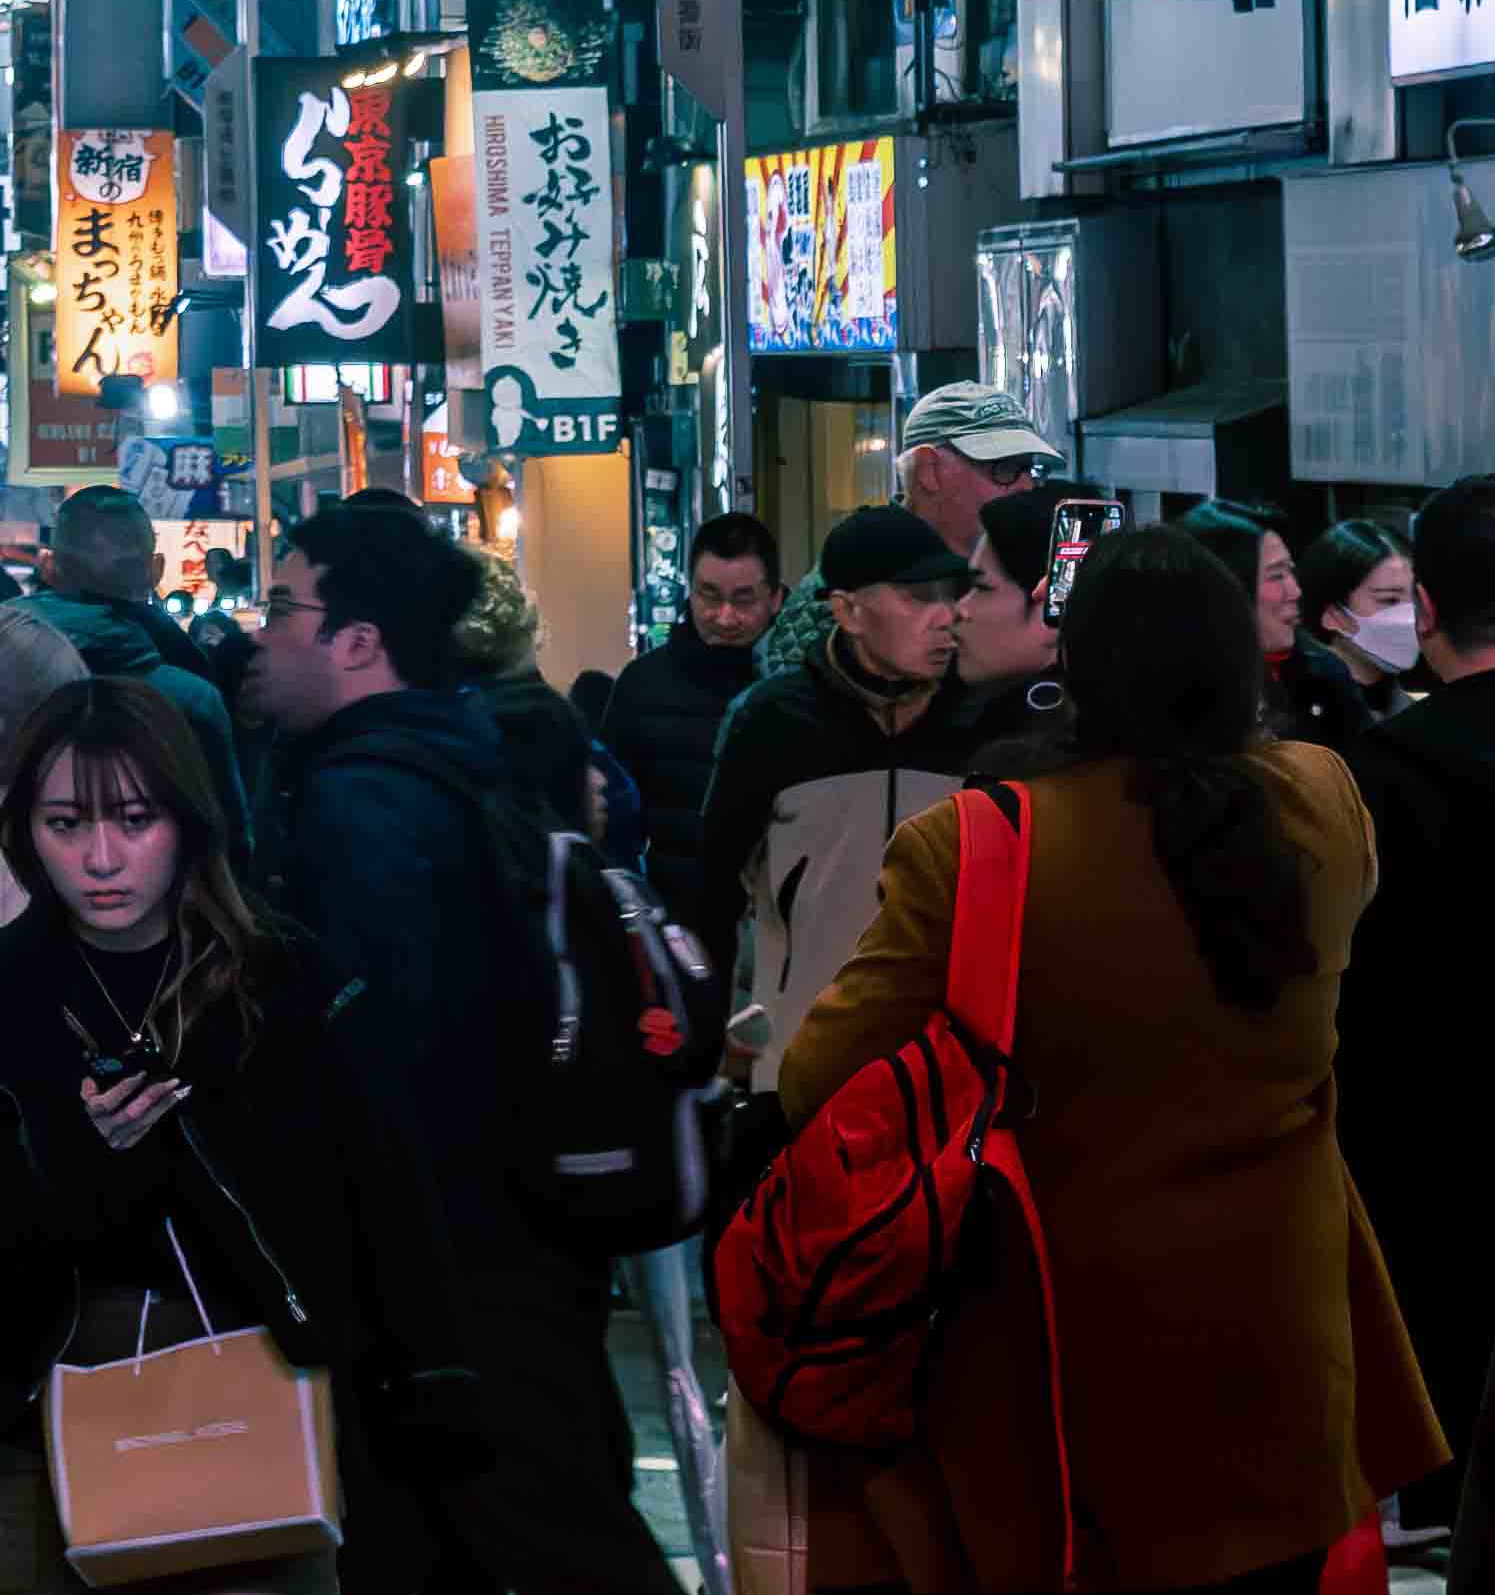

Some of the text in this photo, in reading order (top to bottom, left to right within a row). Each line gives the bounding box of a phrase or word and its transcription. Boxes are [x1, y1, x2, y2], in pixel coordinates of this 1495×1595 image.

[74, 144, 144, 202] 新宿の
[484, 114, 507, 217] HIROSHIMA
[519, 112, 608, 370] お好み焼き
[71, 208, 126, 379] まっちゃん
[551, 413, 619, 442] B1F
